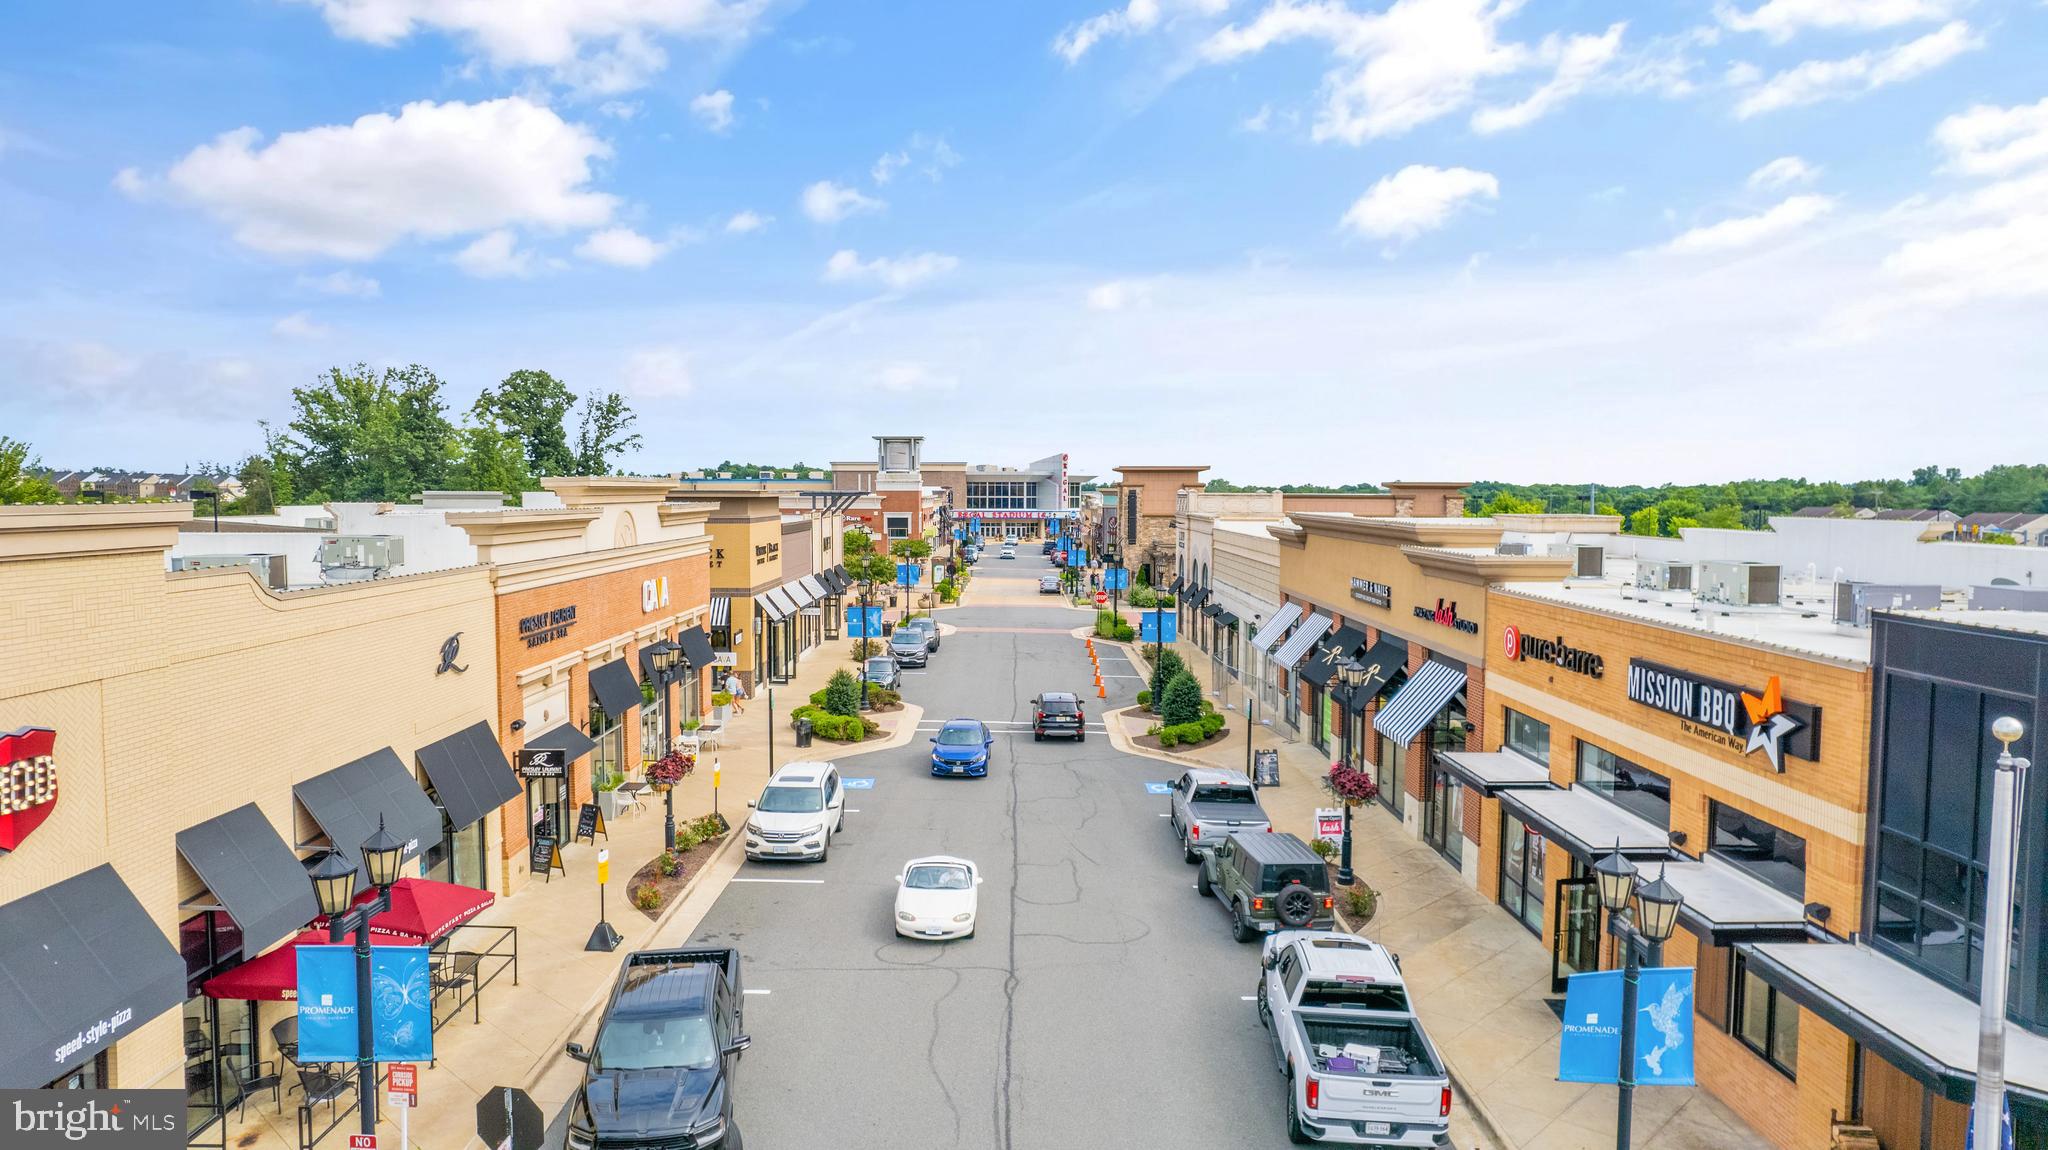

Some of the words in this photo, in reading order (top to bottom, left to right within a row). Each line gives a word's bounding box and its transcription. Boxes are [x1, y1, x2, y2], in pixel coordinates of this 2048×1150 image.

[642, 576, 669, 613] CAVA
[1520, 633, 1555, 663] pure
[1555, 636, 1604, 679] barre
[1627, 664, 1693, 718] MISSION
[1700, 685, 1736, 736] BBQ
[1680, 719, 1692, 734] The
[1693, 726, 1726, 746] American
[1322, 821, 1341, 832] lash
[370, 926, 391, 936] PIZZA
[430, 913, 463, 940] SUPERFAST
[299, 1005, 355, 1014] PROMENADE
[1564, 1024, 1619, 1035] PROMENADE
[1362, 1089, 1400, 1098] GMC
[355, 1136, 371, 1148] NO
